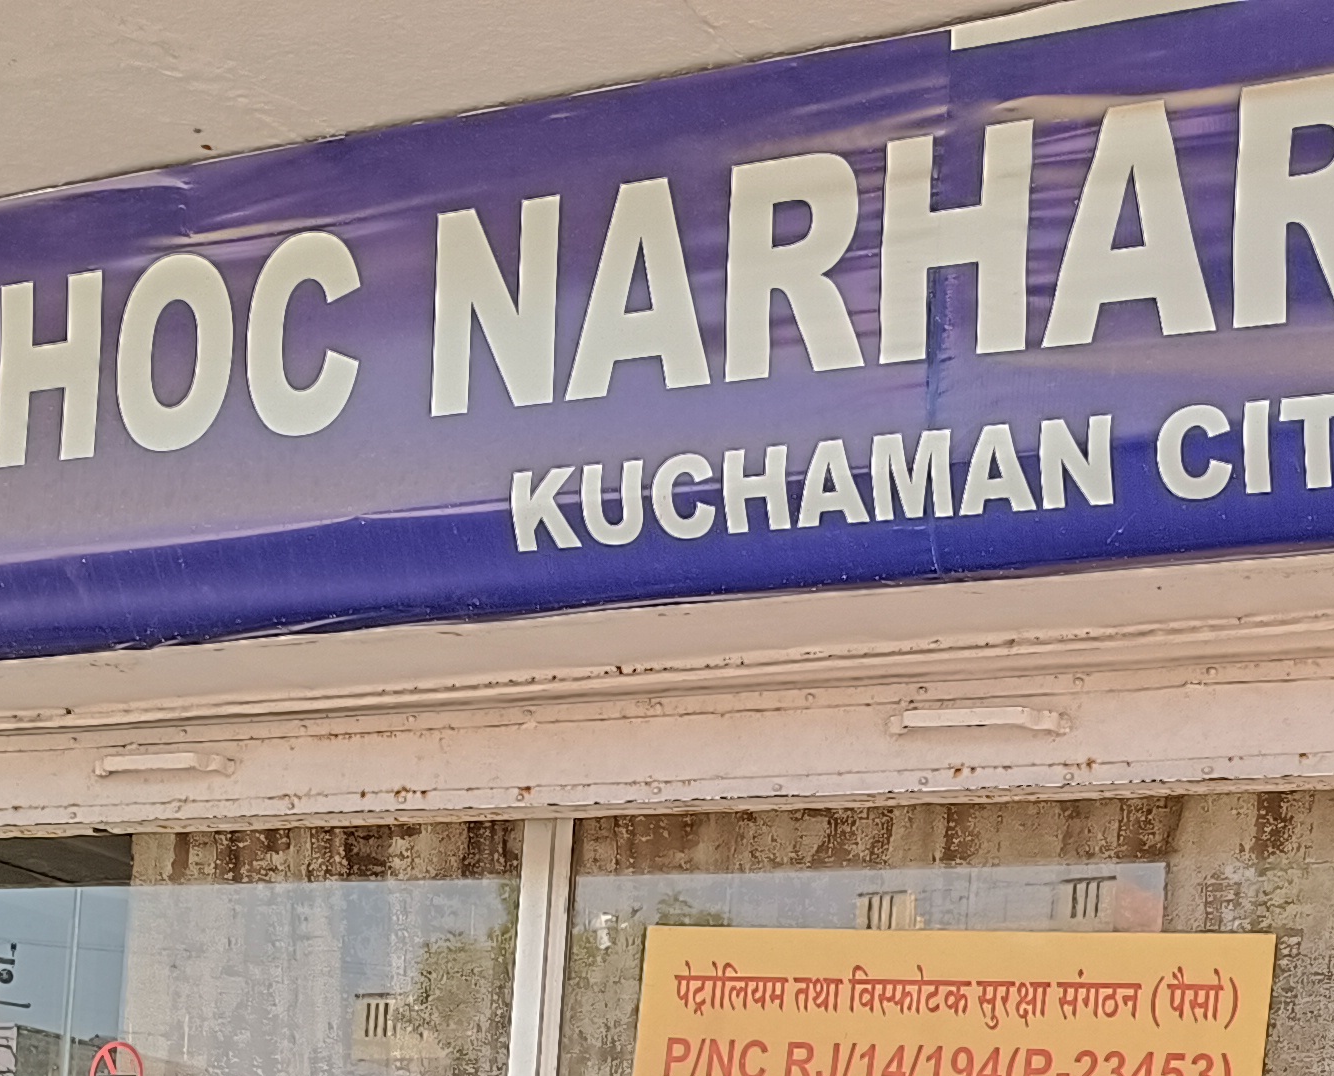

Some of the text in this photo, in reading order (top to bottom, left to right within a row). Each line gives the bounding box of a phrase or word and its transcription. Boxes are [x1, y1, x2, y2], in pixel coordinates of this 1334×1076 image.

[509, 415, 1114, 551] KUCHAMAN
[674, 960, 789, 1016] पेट्रोलियम
[793, 977, 844, 1014] तथा
[848, 964, 972, 1017] विस्फोटक
[976, 979, 1051, 1030] सुरक्षा
[1056, 968, 1142, 1020] संगठन
